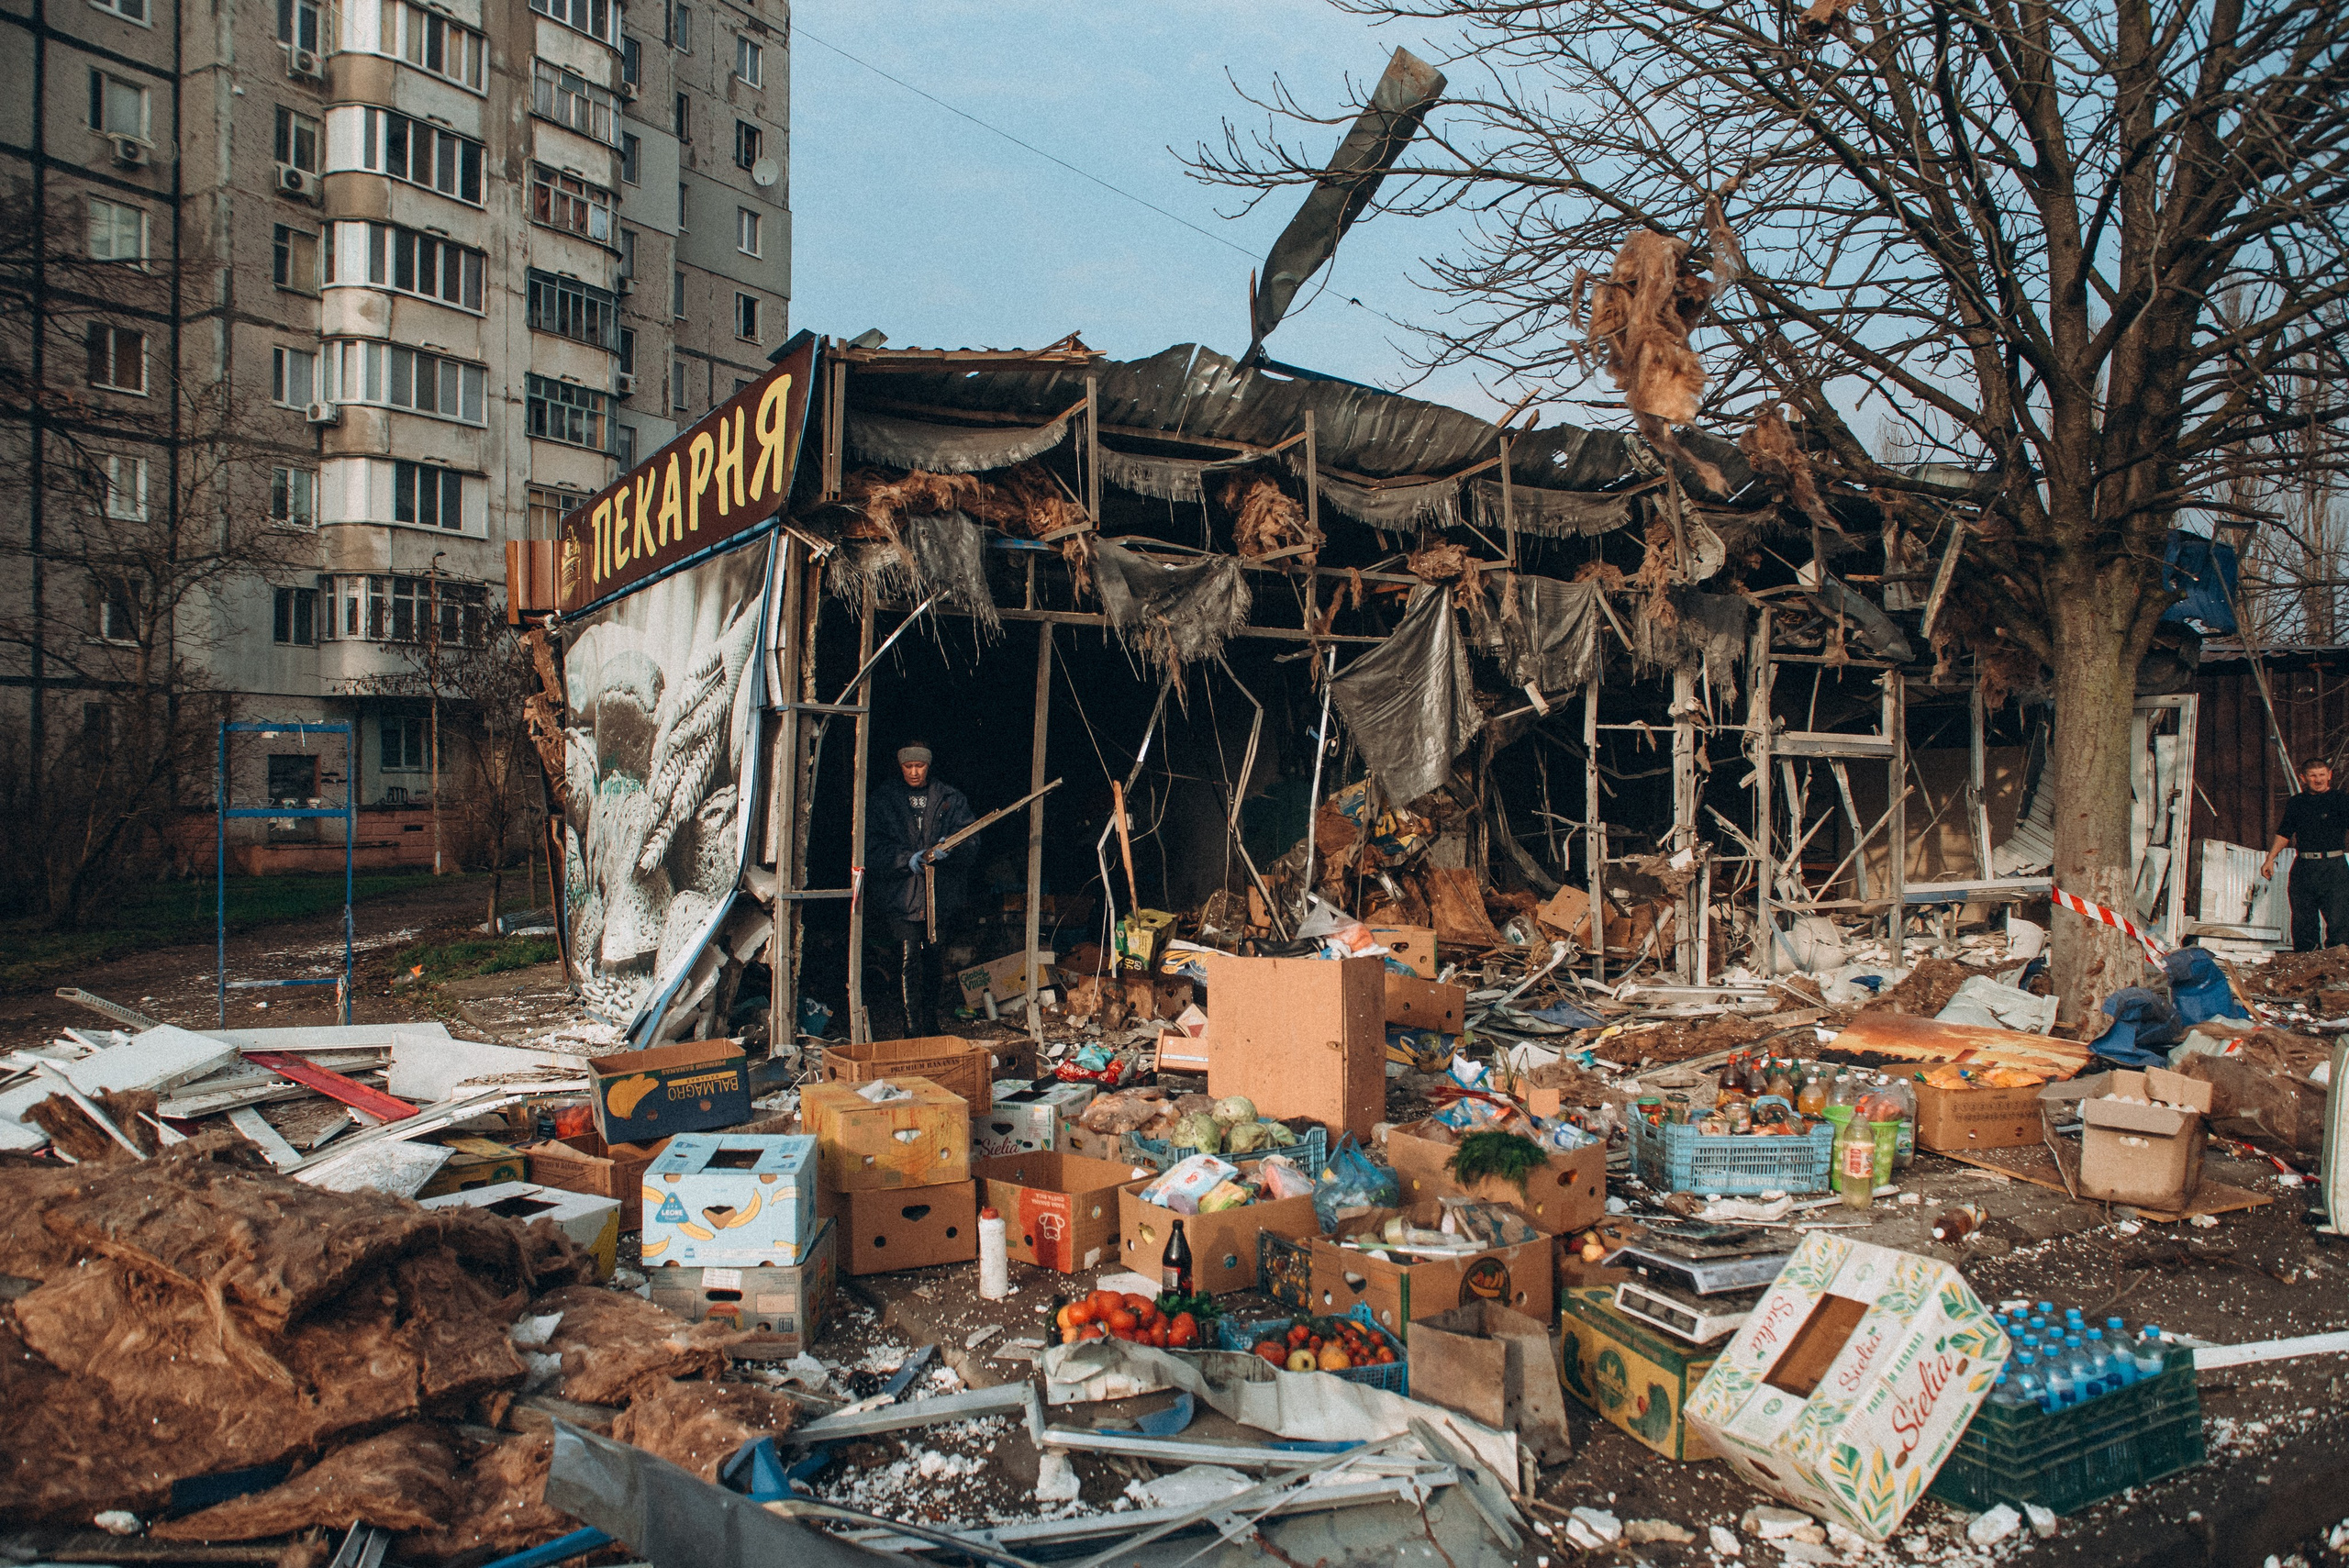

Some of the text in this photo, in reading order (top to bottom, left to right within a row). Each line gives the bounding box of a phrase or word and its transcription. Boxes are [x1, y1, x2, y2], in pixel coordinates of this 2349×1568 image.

[591, 373, 793, 584] ПЕКАРНЯ
[960, 966, 985, 984] Global
[963, 975, 992, 991] Village
[661, 1060, 727, 1075] PREMIUM BANANAS
[890, 1058, 960, 1073] PREMIUM BANANAS
[667, 1075, 740, 1102] BALMAGRO
[686, 1074, 719, 1083] BANANAS
[979, 1137, 1020, 1156] Sielia
[1751, 1296, 1794, 1351] Sielia
[1838, 1333, 1882, 1392] Sielia
[1894, 1331, 1925, 1373] BANANAS
[1891, 1351, 1953, 1452] Sielia
